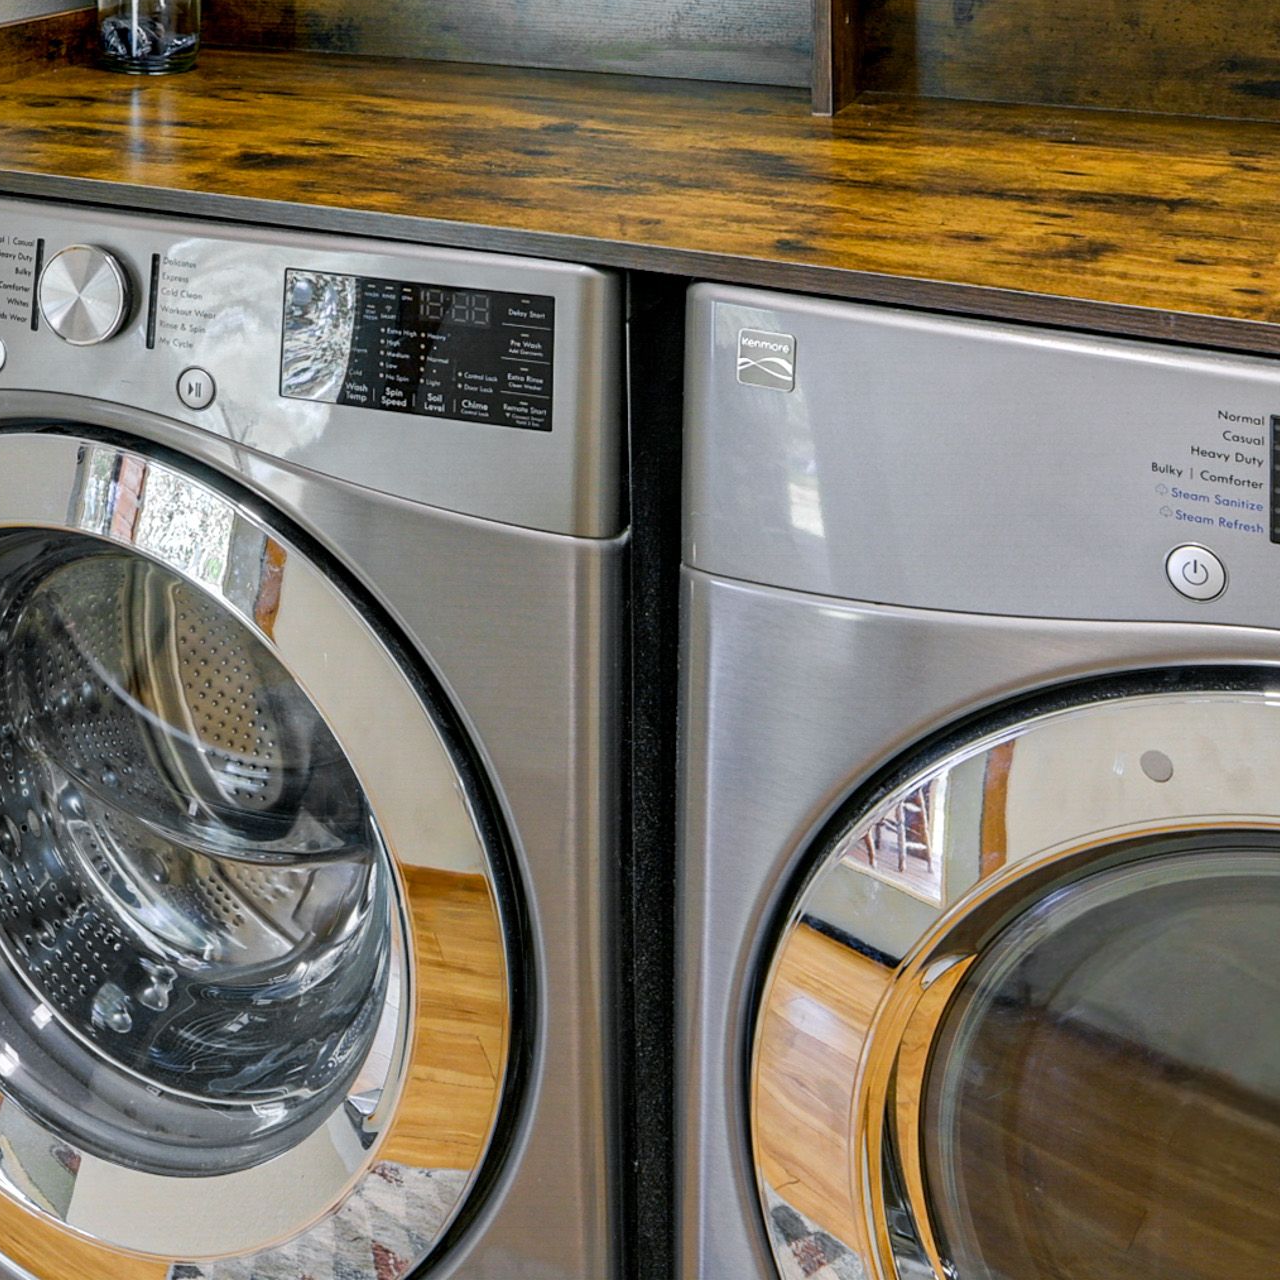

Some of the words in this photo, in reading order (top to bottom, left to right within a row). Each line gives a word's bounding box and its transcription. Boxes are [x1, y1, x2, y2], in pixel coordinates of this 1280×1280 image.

[13, 237, 34, 247] Casual
[18, 253, 33, 262] Duty
[162, 257, 196, 268] Delicates
[15, 267, 31, 276] Bulky
[162, 272, 189, 283] Express
[161, 287, 178, 297] Cold
[7, 297, 29, 307] Whites
[160, 305, 192, 316] Workout
[194, 309, 215, 319] Wear
[508, 308, 527, 318] Delay
[529, 310, 546, 319] Start
[10, 314, 27, 322] Wear
[403, 329, 417, 338] High
[427, 334, 446, 342] Heavy
[172, 339, 194, 348] Cycle
[510, 340, 521, 348] Pre
[522, 341, 542, 350] Wash
[742, 337, 790, 354] Kenmore
[386, 351, 410, 359] Medium
[426, 356, 449, 364] Normal
[464, 372, 484, 380] Control
[485, 374, 498, 382] Lock
[507, 373, 525, 382] Extra
[526, 376, 544, 384] Rinse
[345, 382, 368, 392] Wash
[426, 379, 440, 387] Light
[346, 391, 367, 403] Temp
[385, 387, 403, 397] Spin
[381, 395, 407, 407] Speed
[427, 393, 442, 402] Soil
[424, 402, 445, 412] Level
[462, 400, 488, 411] Chime
[503, 403, 528, 413] Remote
[530, 407, 547, 416] Start
[1217, 410, 1265, 426] Normal
[1222, 430, 1265, 446] Casual
[1191, 445, 1230, 462] Heavy
[1235, 452, 1264, 467] Duty
[1151, 462, 1183, 477] Bulky
[1200, 470, 1264, 489] Comforter
[1171, 487, 1210, 503] Steam
[1214, 494, 1263, 511] Sanitize
[1176, 509, 1214, 525] Steam
[1219, 517, 1264, 533] Refresh
